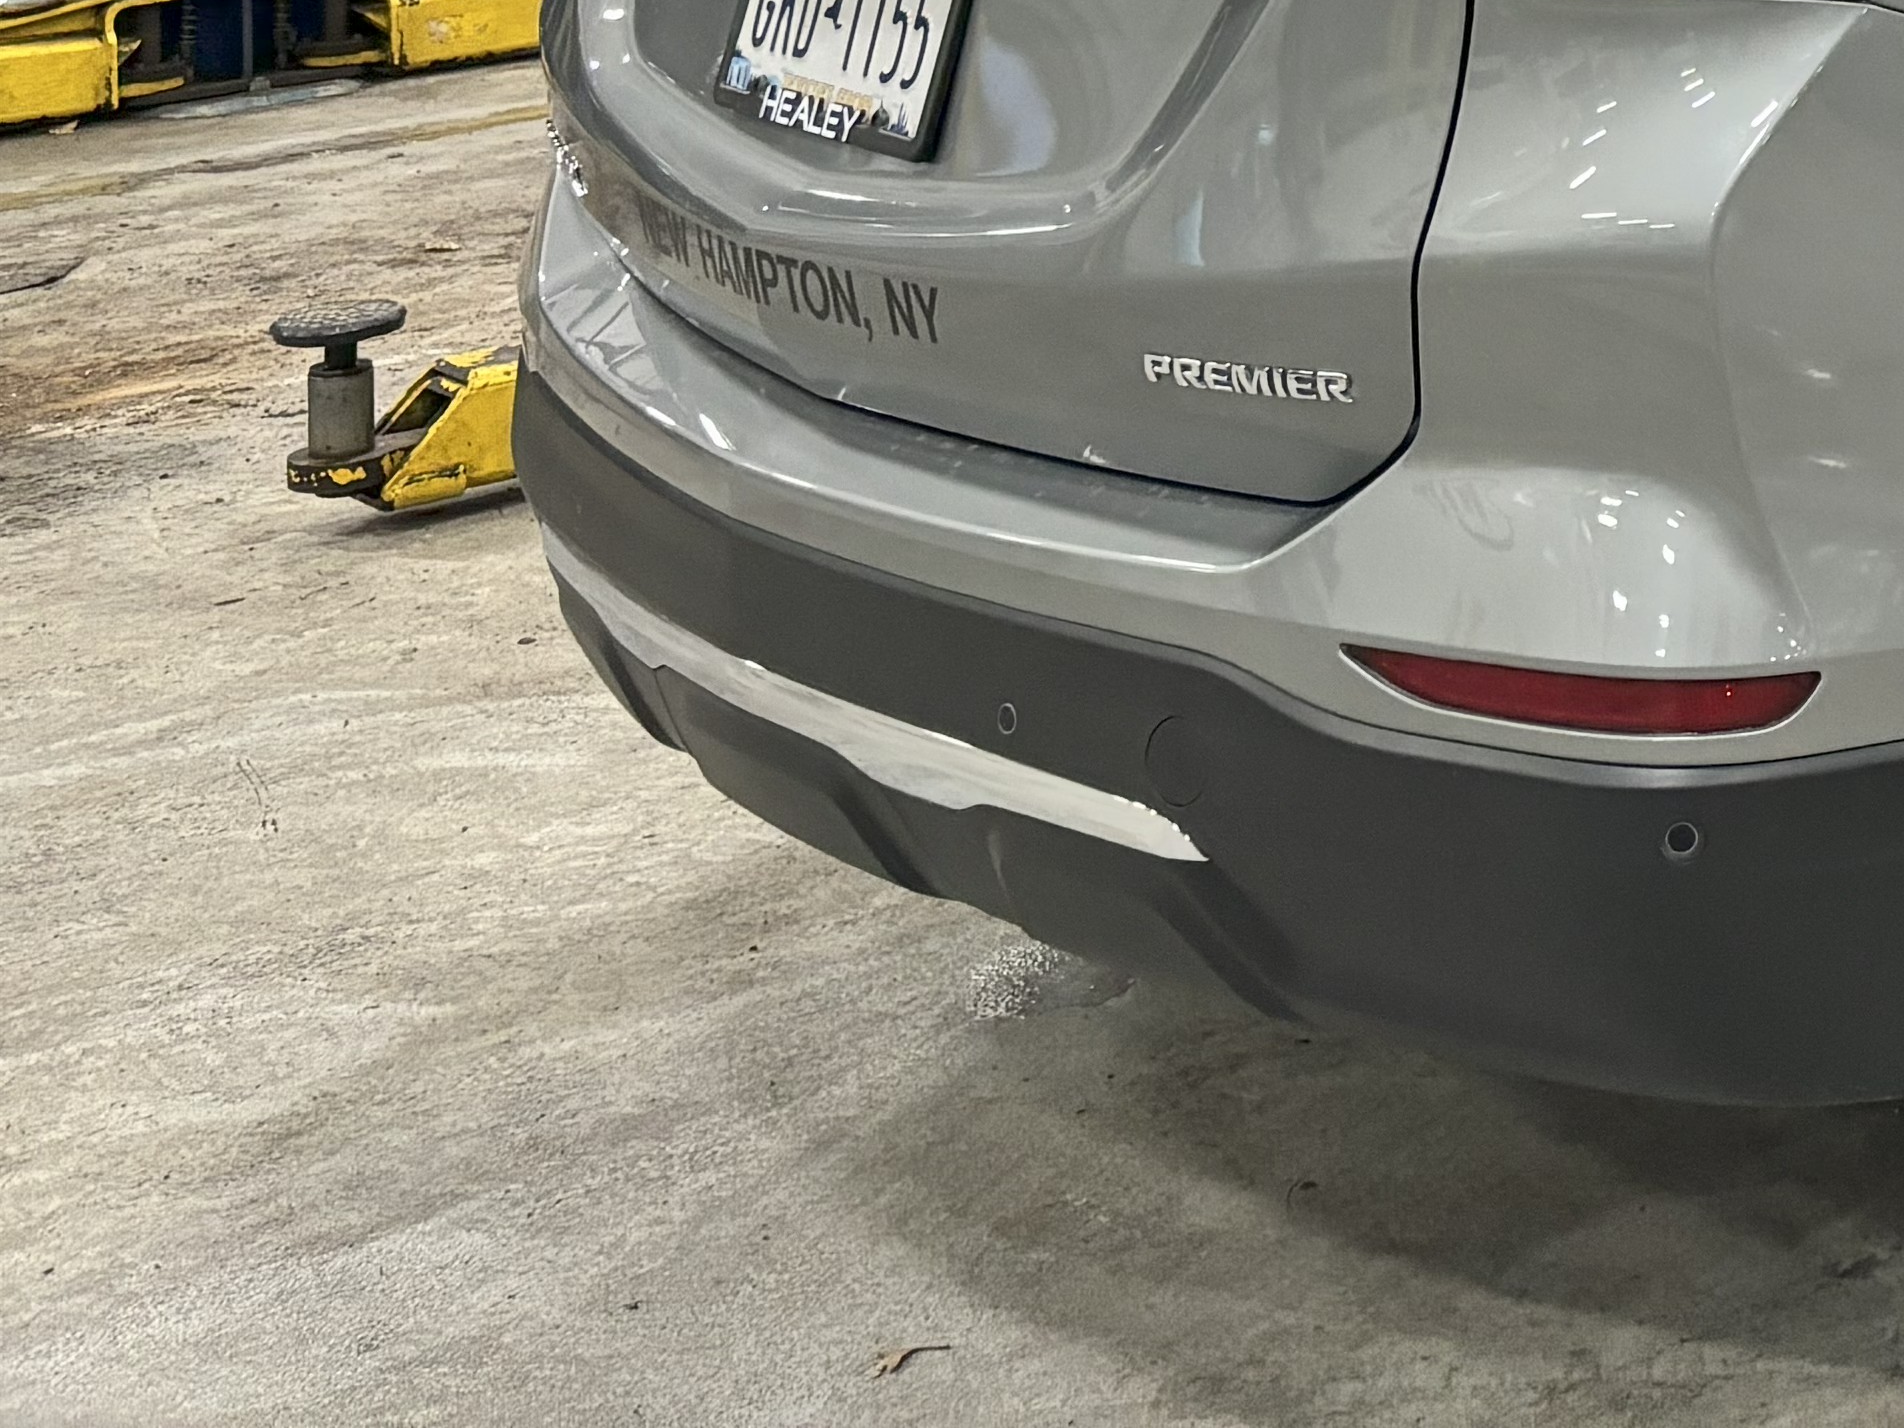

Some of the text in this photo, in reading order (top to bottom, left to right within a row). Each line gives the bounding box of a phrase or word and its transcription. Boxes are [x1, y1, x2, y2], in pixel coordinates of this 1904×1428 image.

[758, 84, 860, 143] HEALEY
[636, 190, 939, 344] NEW HAMPTON, NY
[1144, 354, 1354, 403] PREMIER
